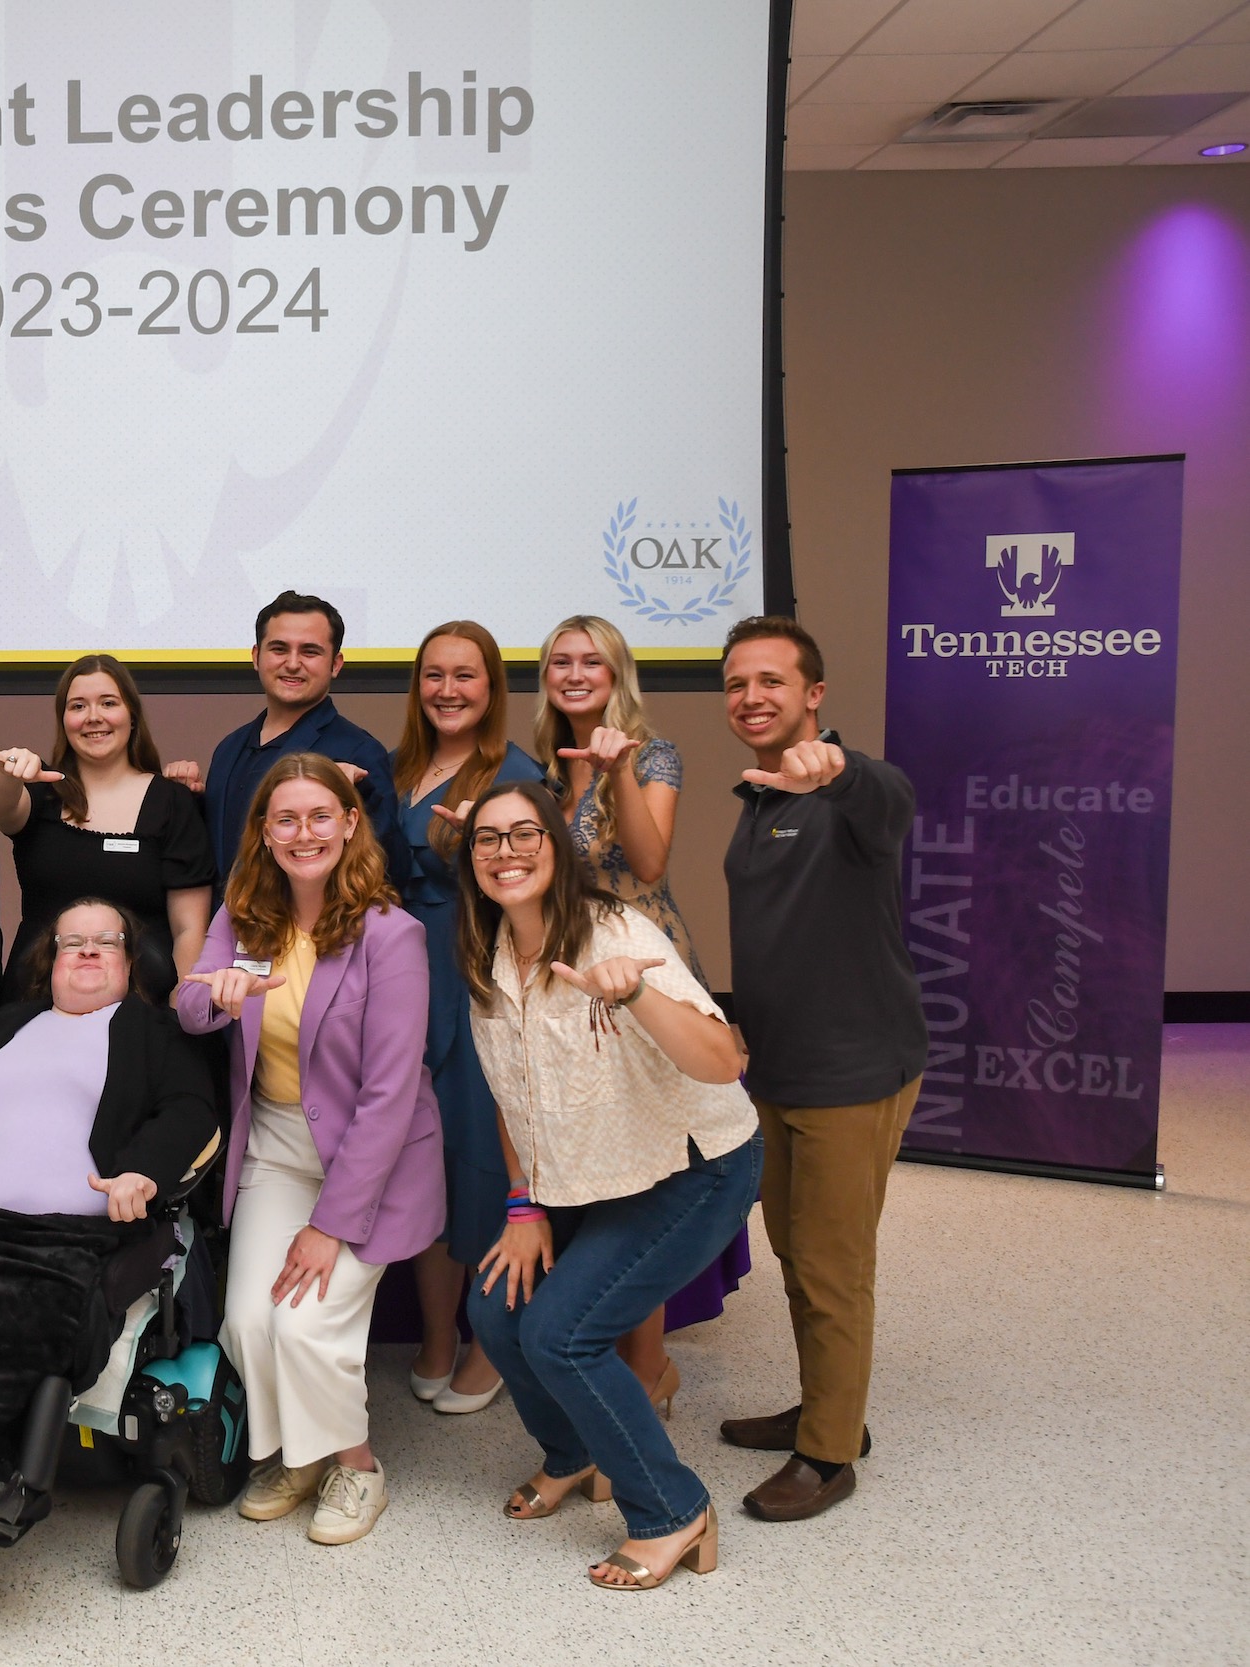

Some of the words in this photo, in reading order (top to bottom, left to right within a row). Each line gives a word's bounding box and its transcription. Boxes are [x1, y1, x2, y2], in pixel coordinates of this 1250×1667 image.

[67, 70, 535, 153] Leadership
[79, 173, 510, 252] Ceremony
[664, 576, 693, 585] 1914
[901, 624, 1162, 658] Tennessee
[985, 659, 1069, 678] TECH
[966, 774, 1155, 814] Educate
[1026, 816, 1104, 1050] Compete
[973, 1045, 1145, 1100] EXCEL
